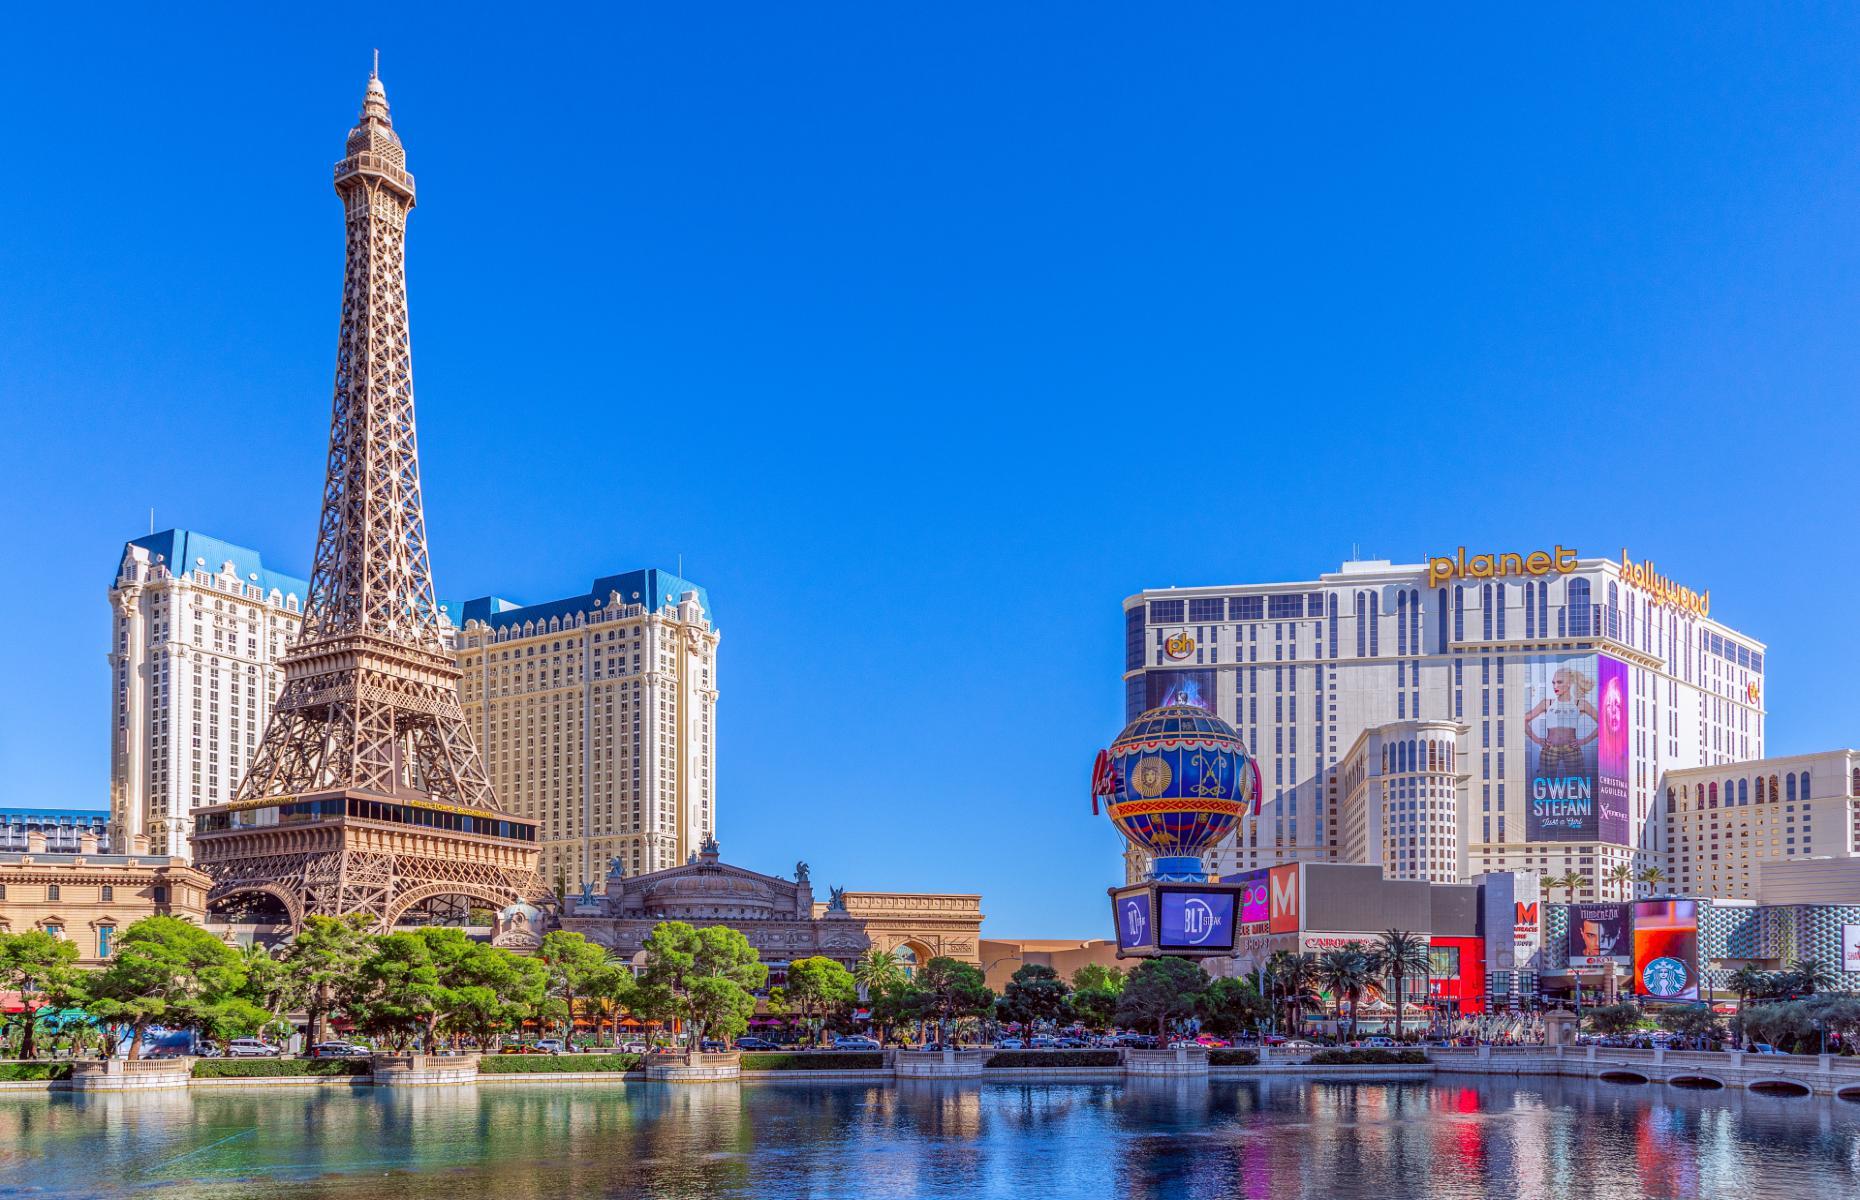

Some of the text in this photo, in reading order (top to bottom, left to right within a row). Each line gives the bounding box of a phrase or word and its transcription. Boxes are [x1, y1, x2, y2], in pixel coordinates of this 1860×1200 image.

[1429, 545, 1710, 617] planet hollywood
[1169, 632, 1195, 657] ph
[1533, 776, 1591, 799] GWEN
[1599, 776, 1628, 789] CHRISTINA
[1600, 786, 1628, 798] AGUILERA
[1533, 799, 1592, 816] STEFANI
[1272, 872, 1296, 919] M
[1184, 907, 1222, 933] BLT STEAK
[1517, 901, 1539, 925] M
